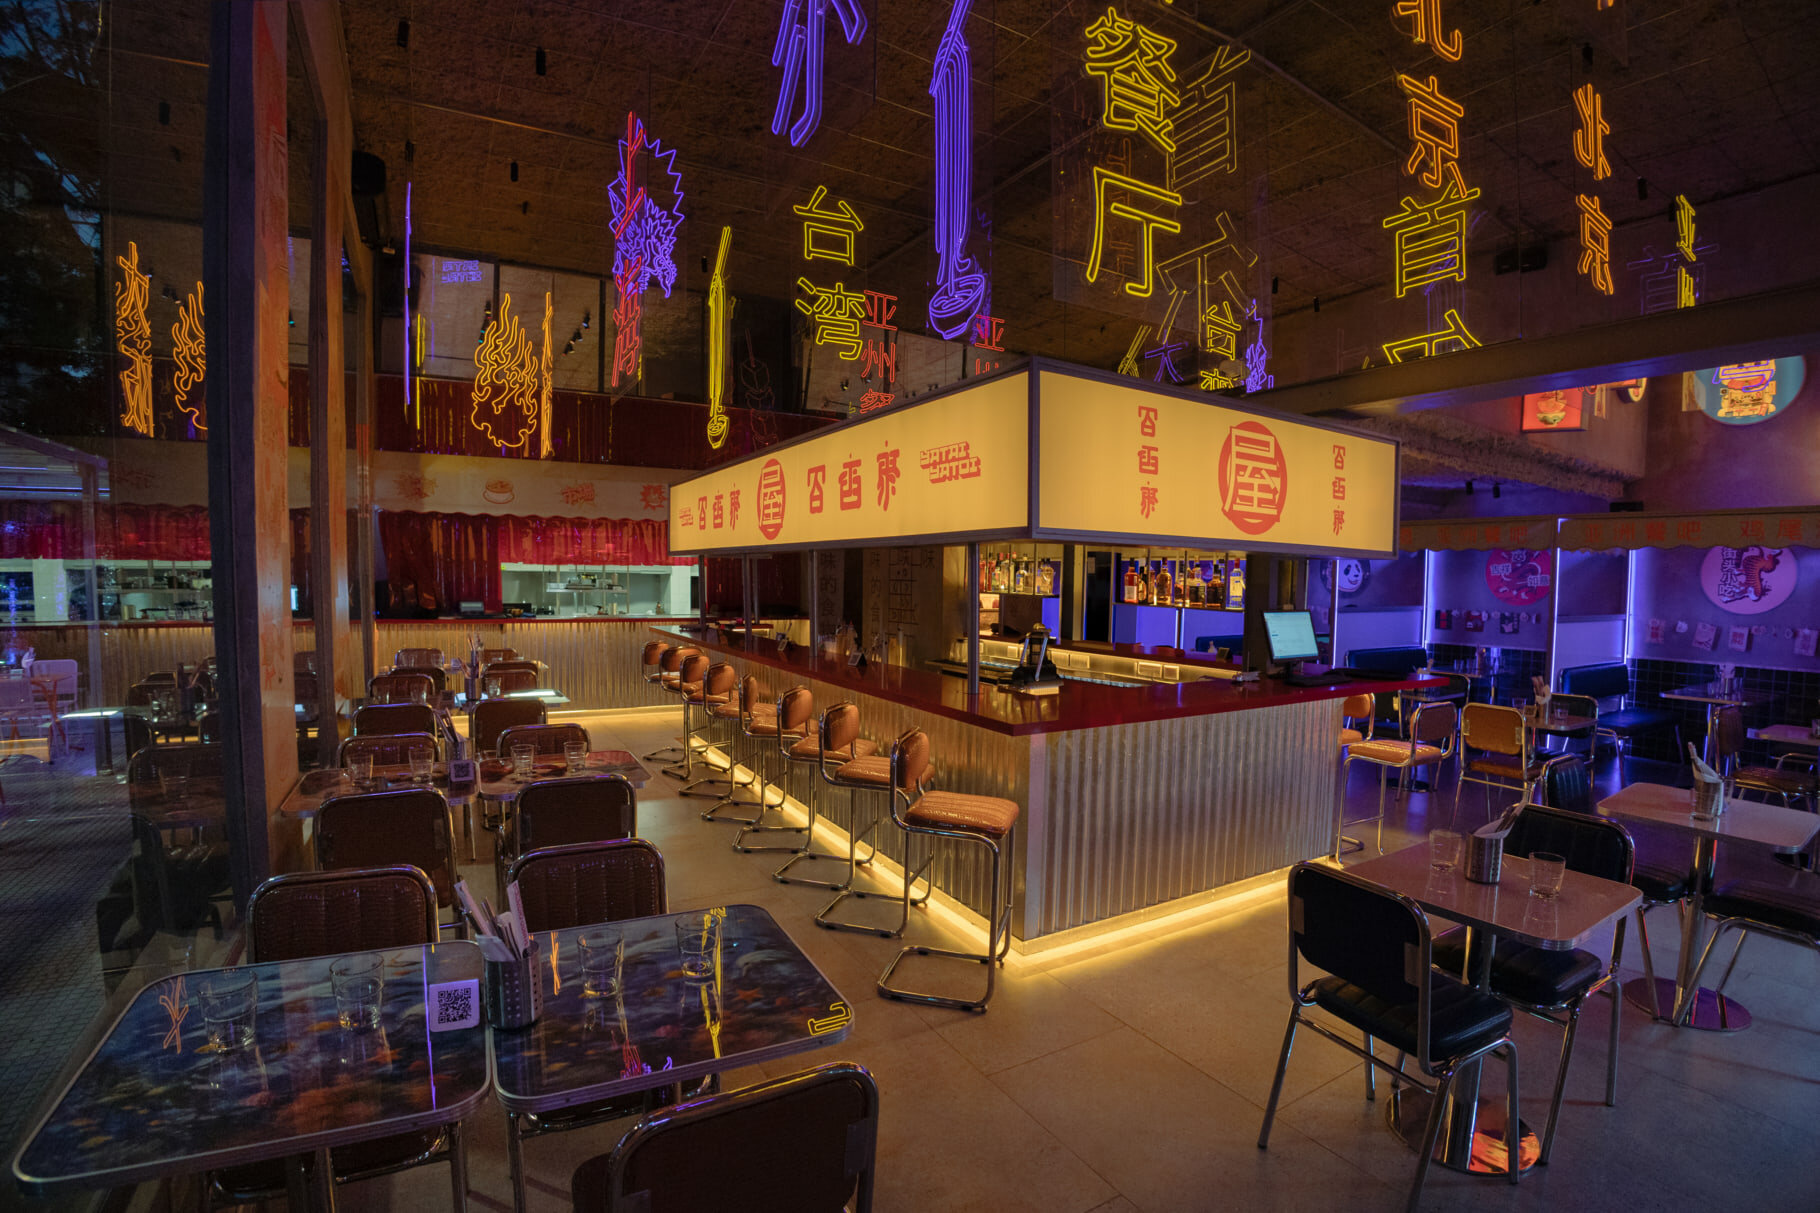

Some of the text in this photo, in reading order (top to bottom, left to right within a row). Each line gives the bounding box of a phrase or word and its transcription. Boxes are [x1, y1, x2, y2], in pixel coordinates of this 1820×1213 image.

[793, 185, 865, 360] 台湾
[919, 441, 970, 470] YATAI
[1739, 517, 1820, 541] 鸡尾
